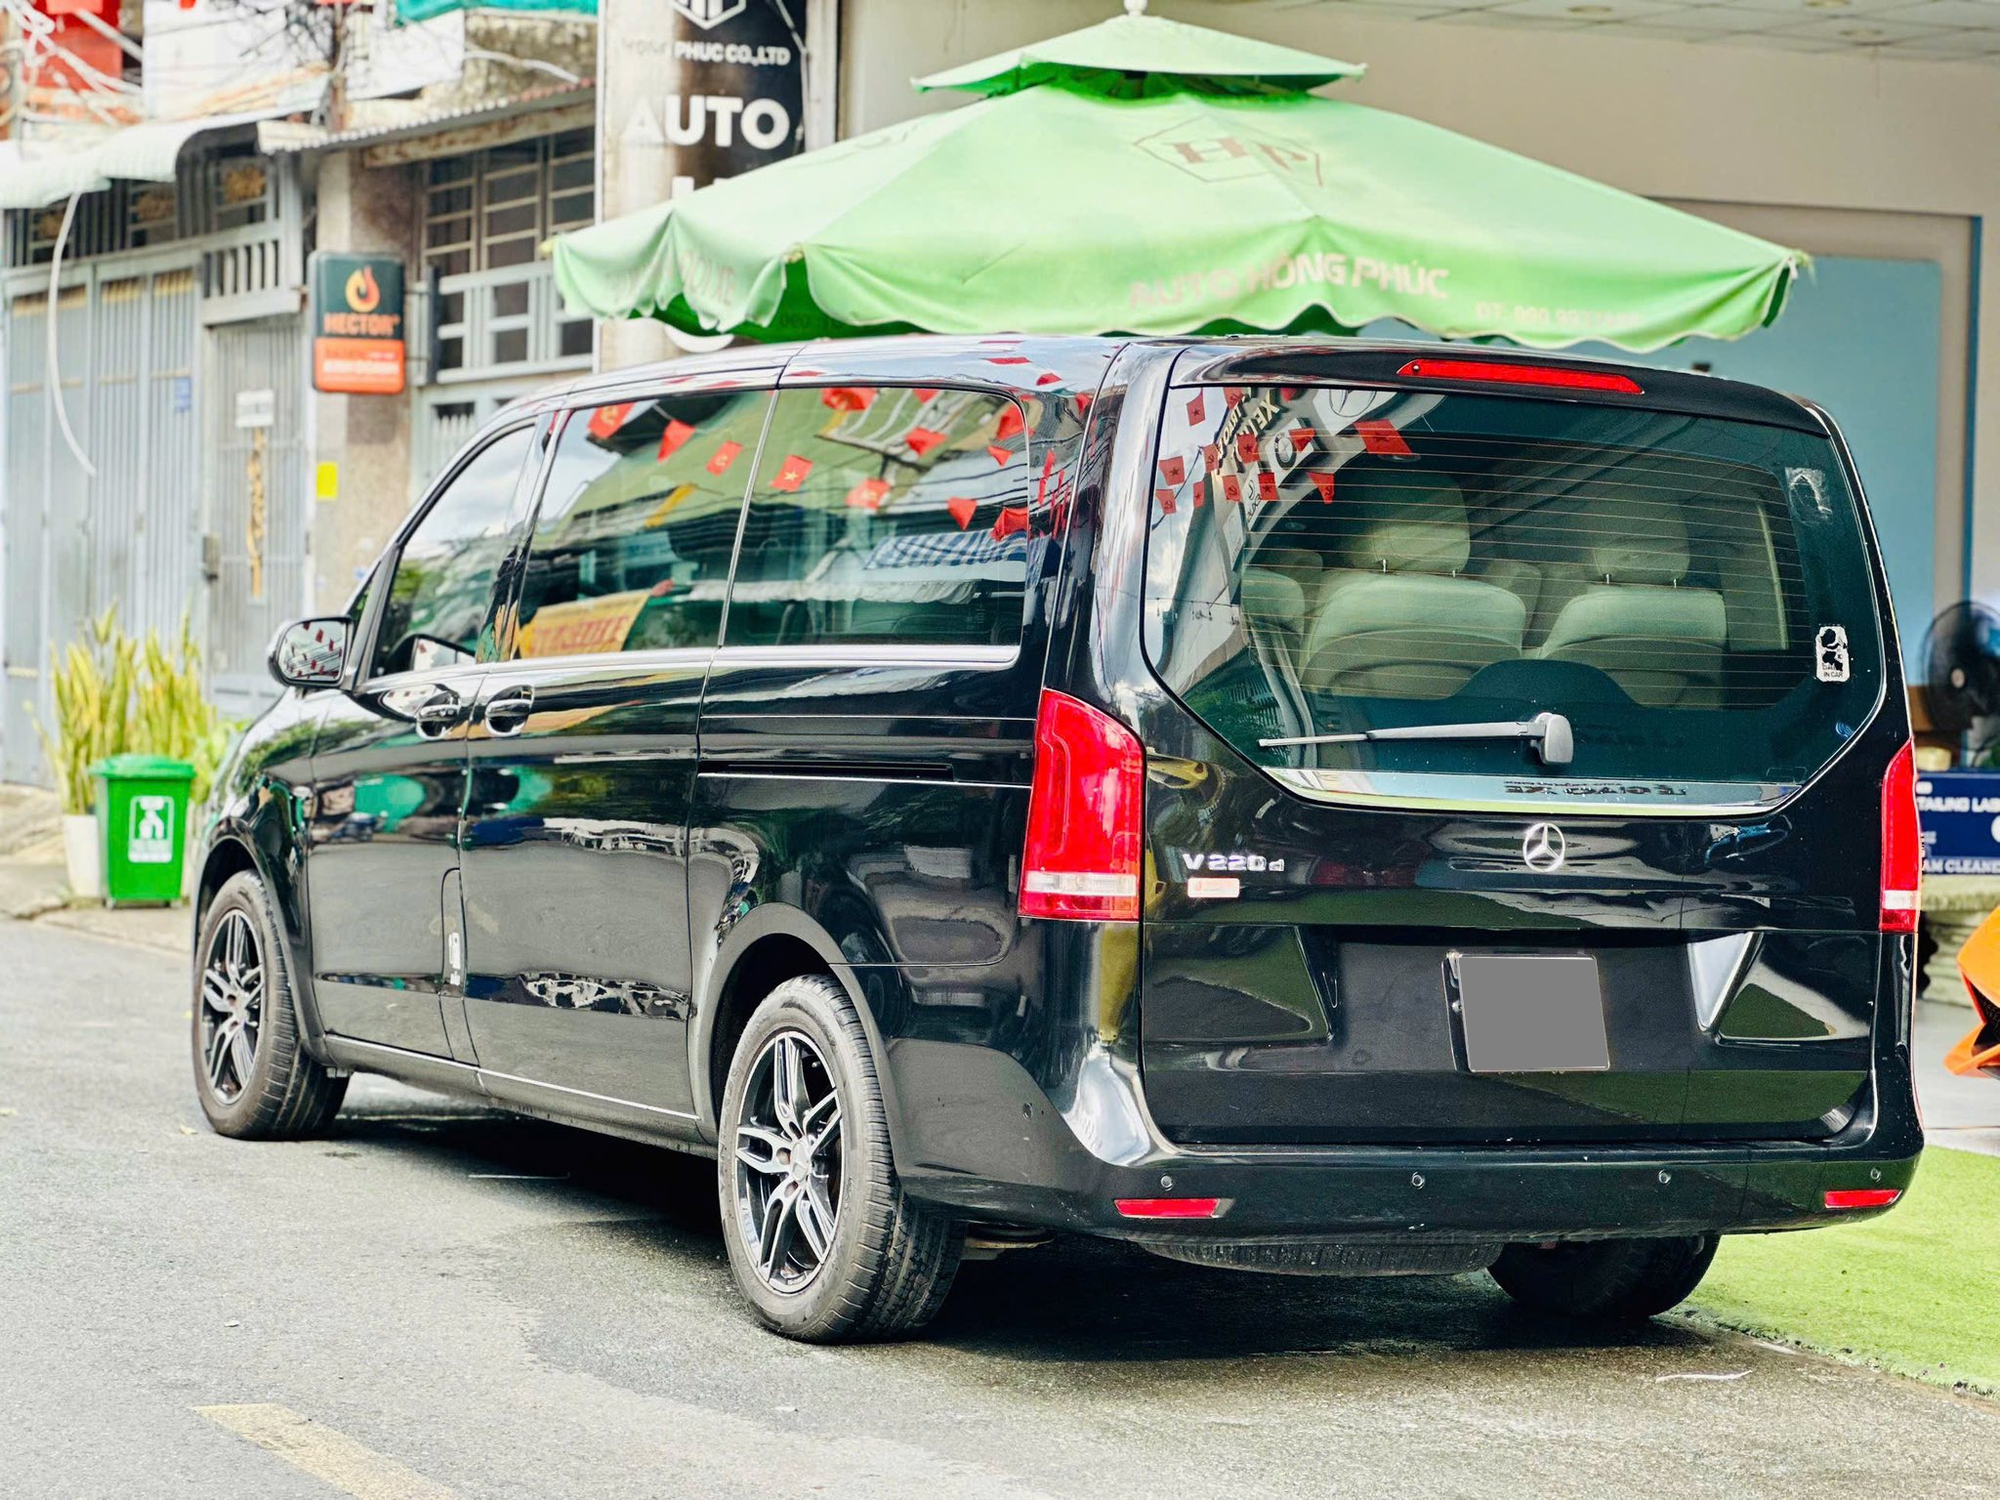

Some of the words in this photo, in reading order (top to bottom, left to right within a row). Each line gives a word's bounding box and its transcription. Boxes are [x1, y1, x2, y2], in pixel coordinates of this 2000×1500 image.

[674, 41, 724, 63] PHUC
[621, 93, 791, 150] AUTO
[1128, 267, 1241, 311] AUTO
[1182, 853, 1205, 870] V
